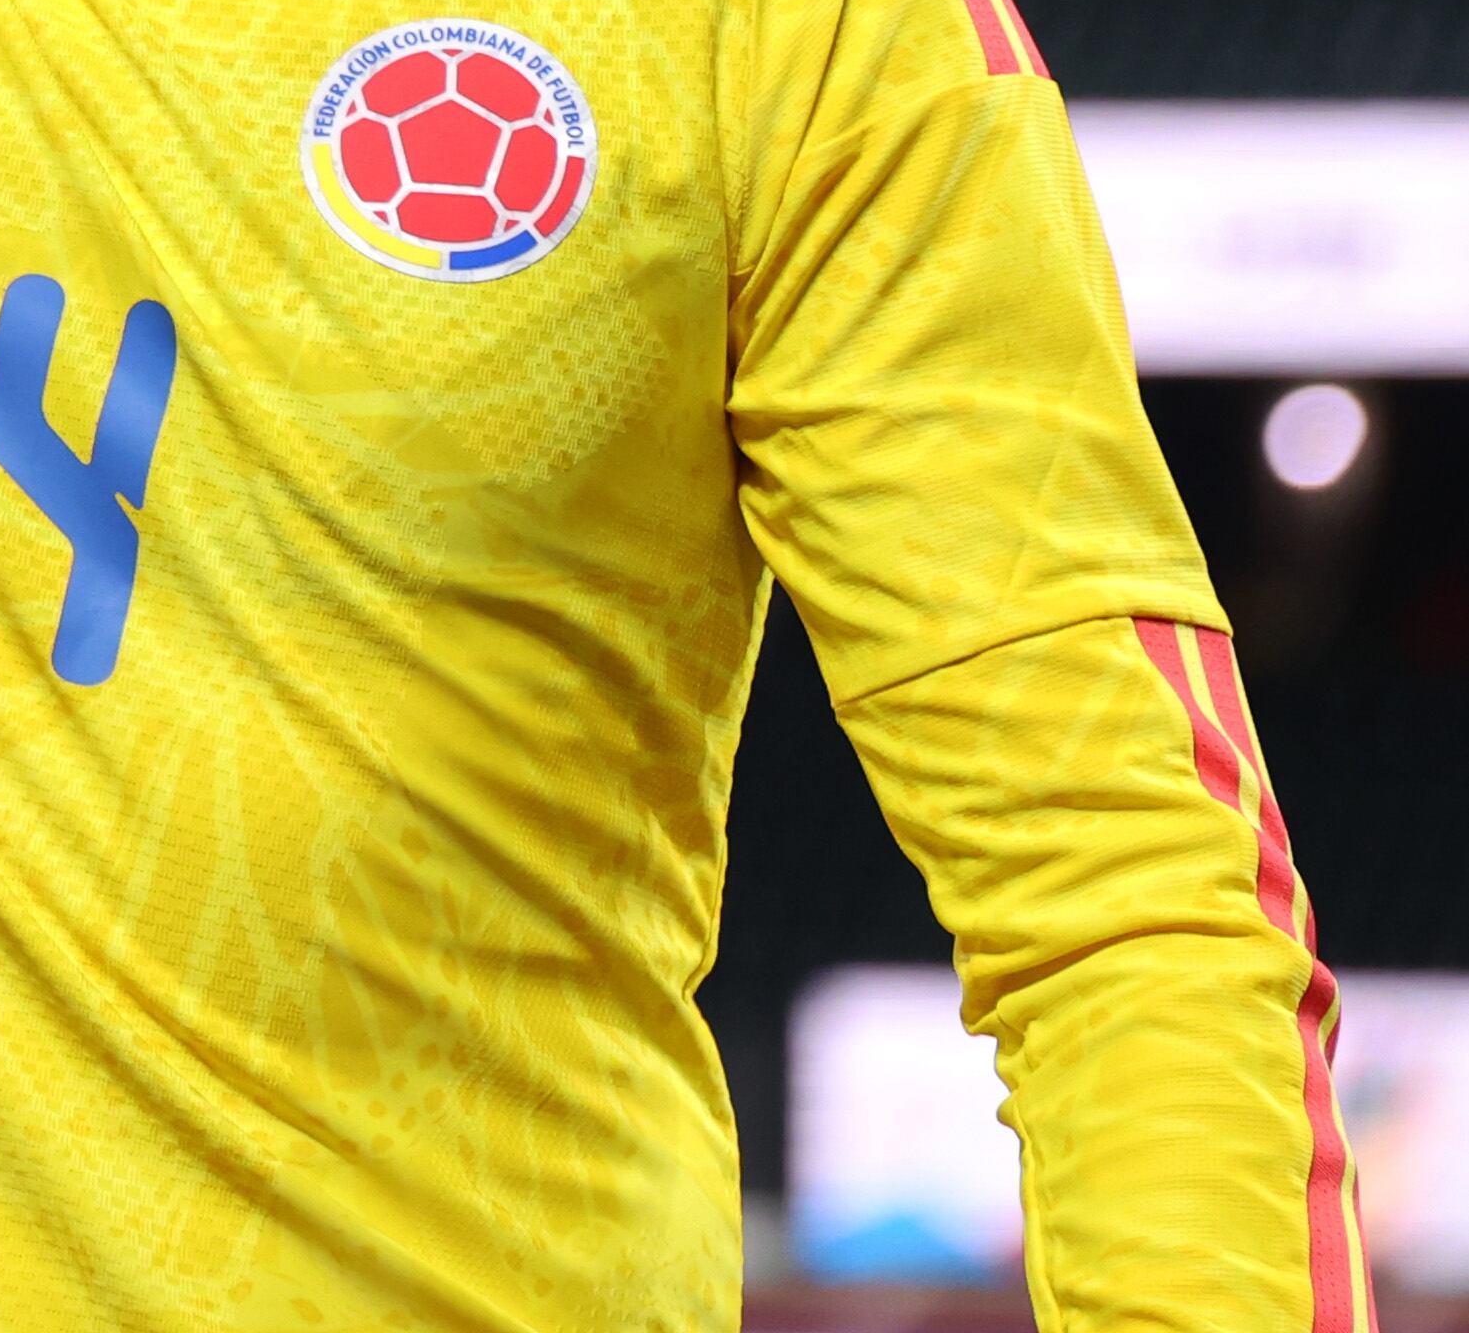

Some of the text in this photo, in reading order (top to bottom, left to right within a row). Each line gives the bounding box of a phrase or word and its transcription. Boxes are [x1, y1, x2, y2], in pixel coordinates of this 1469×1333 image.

[314, 27, 585, 149] FEDERACIÓN COLOMBIANA DE FÚTBOL
